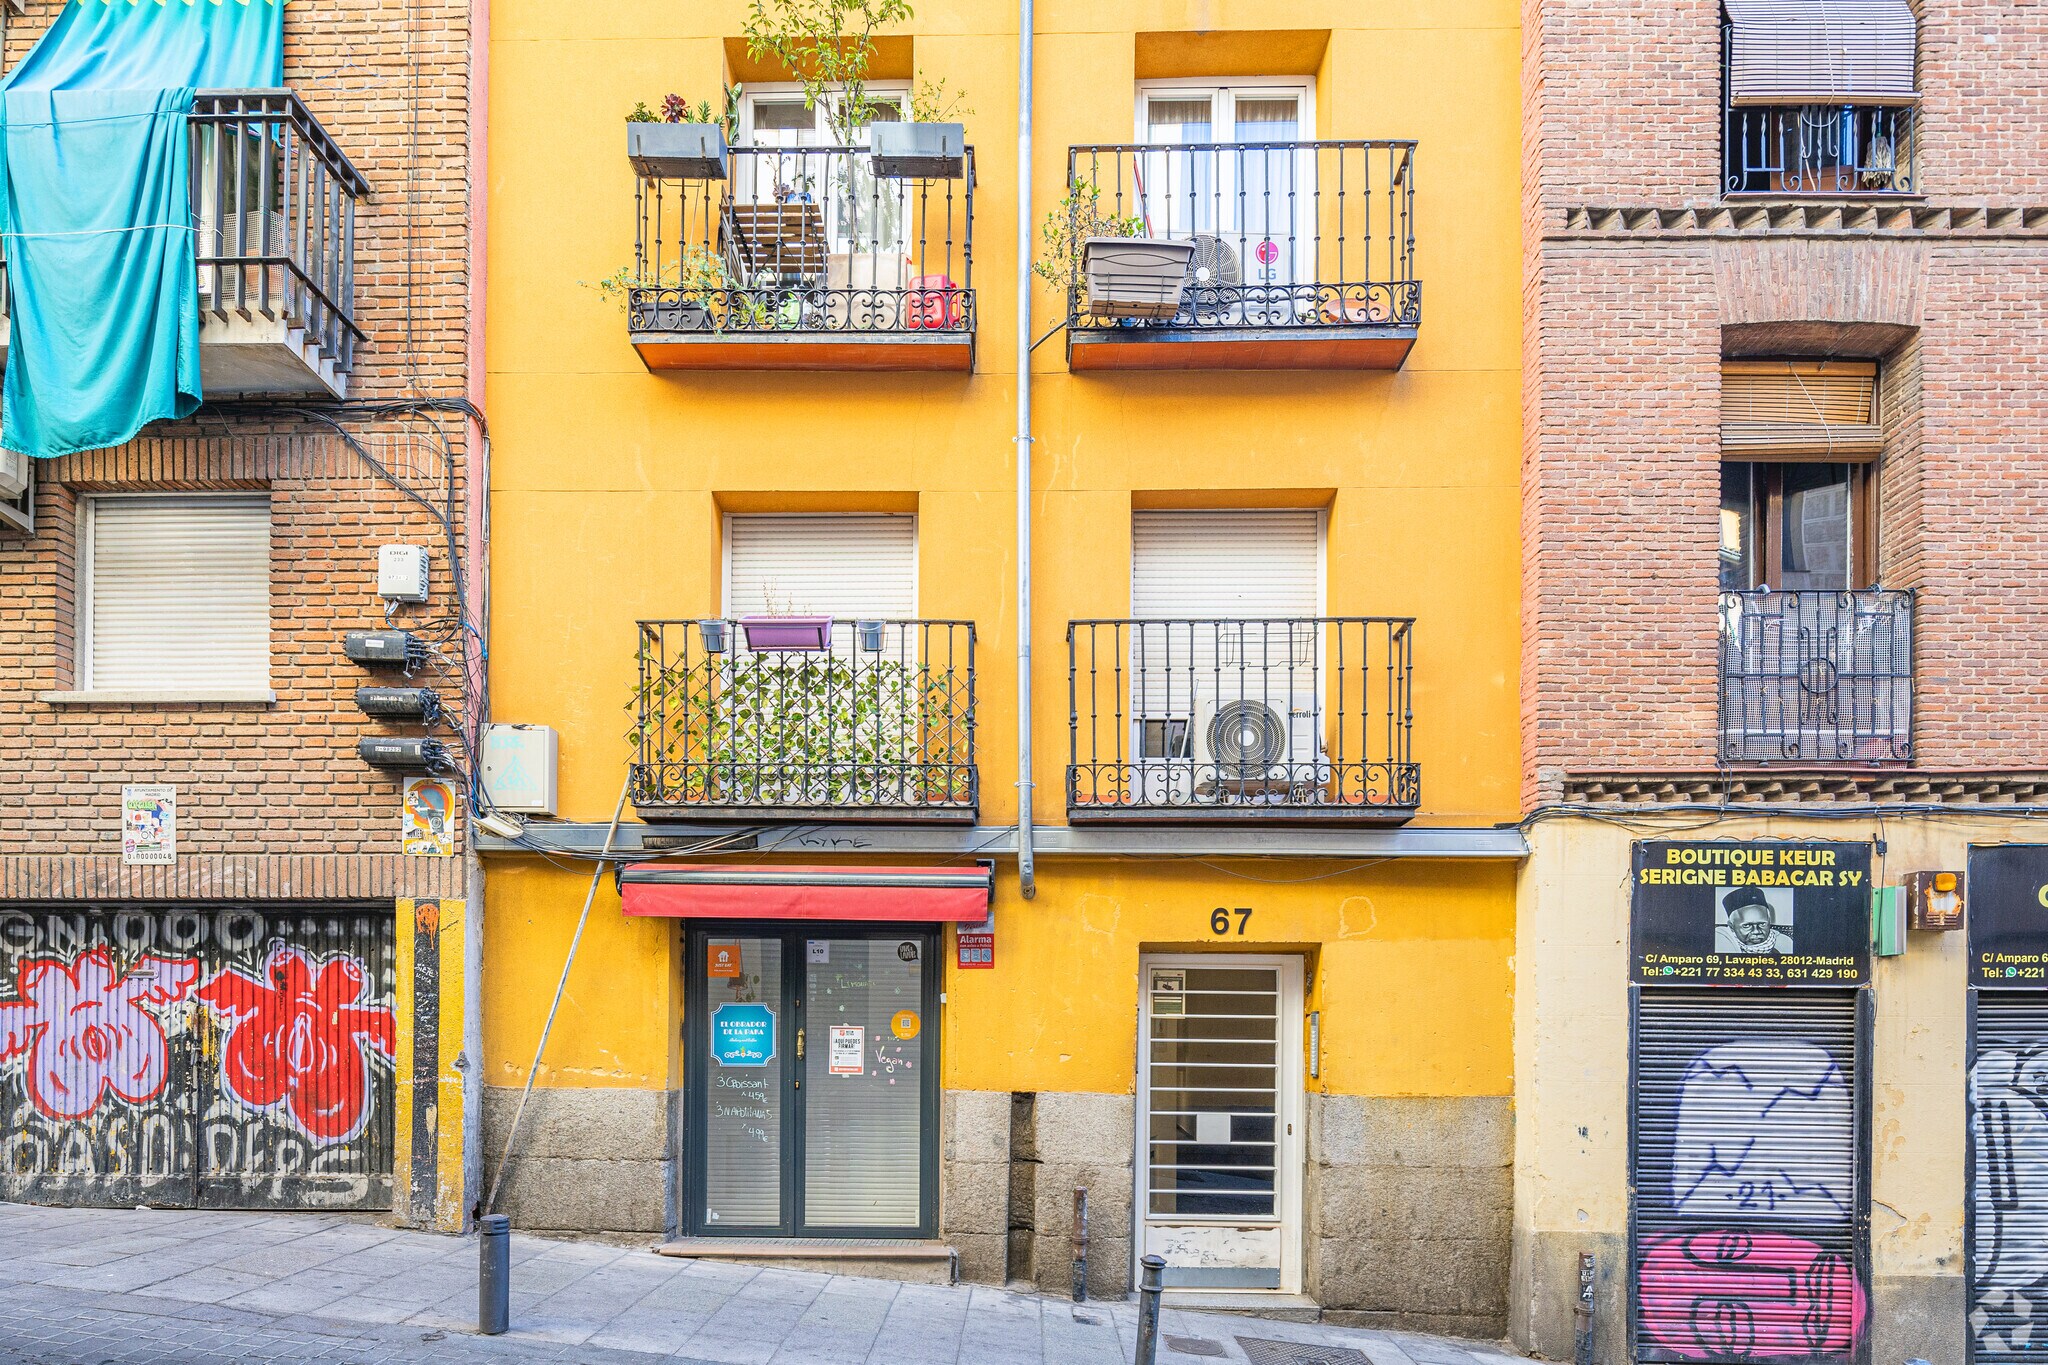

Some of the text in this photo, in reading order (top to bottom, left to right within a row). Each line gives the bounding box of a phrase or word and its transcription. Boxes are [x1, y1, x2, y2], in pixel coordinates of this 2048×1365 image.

[1258, 268, 1277, 280] LG
[1666, 849, 1835, 867] BOUTIQUE KEUR
[1639, 868, 1863, 887] SERIGNE BABACAR SY
[1210, 907, 1252, 935] 67
[960, 935, 992, 944] Alarma
[1645, 954, 1658, 963] C/
[1659, 955, 1703, 966] Amparo
[1706, 955, 1722, 965] 69,
[1780, 956, 1854, 966] 28012-Madrid
[1982, 953, 1994, 963] C/
[1996, 953, 2039, 965] Amparo
[1641, 966, 1858, 980] Tel: +221 77 334 43 33, 631 429 190
[1982, 967, 2045, 978] Tel: +221
[875, 1046, 903, 1073] Vegan
